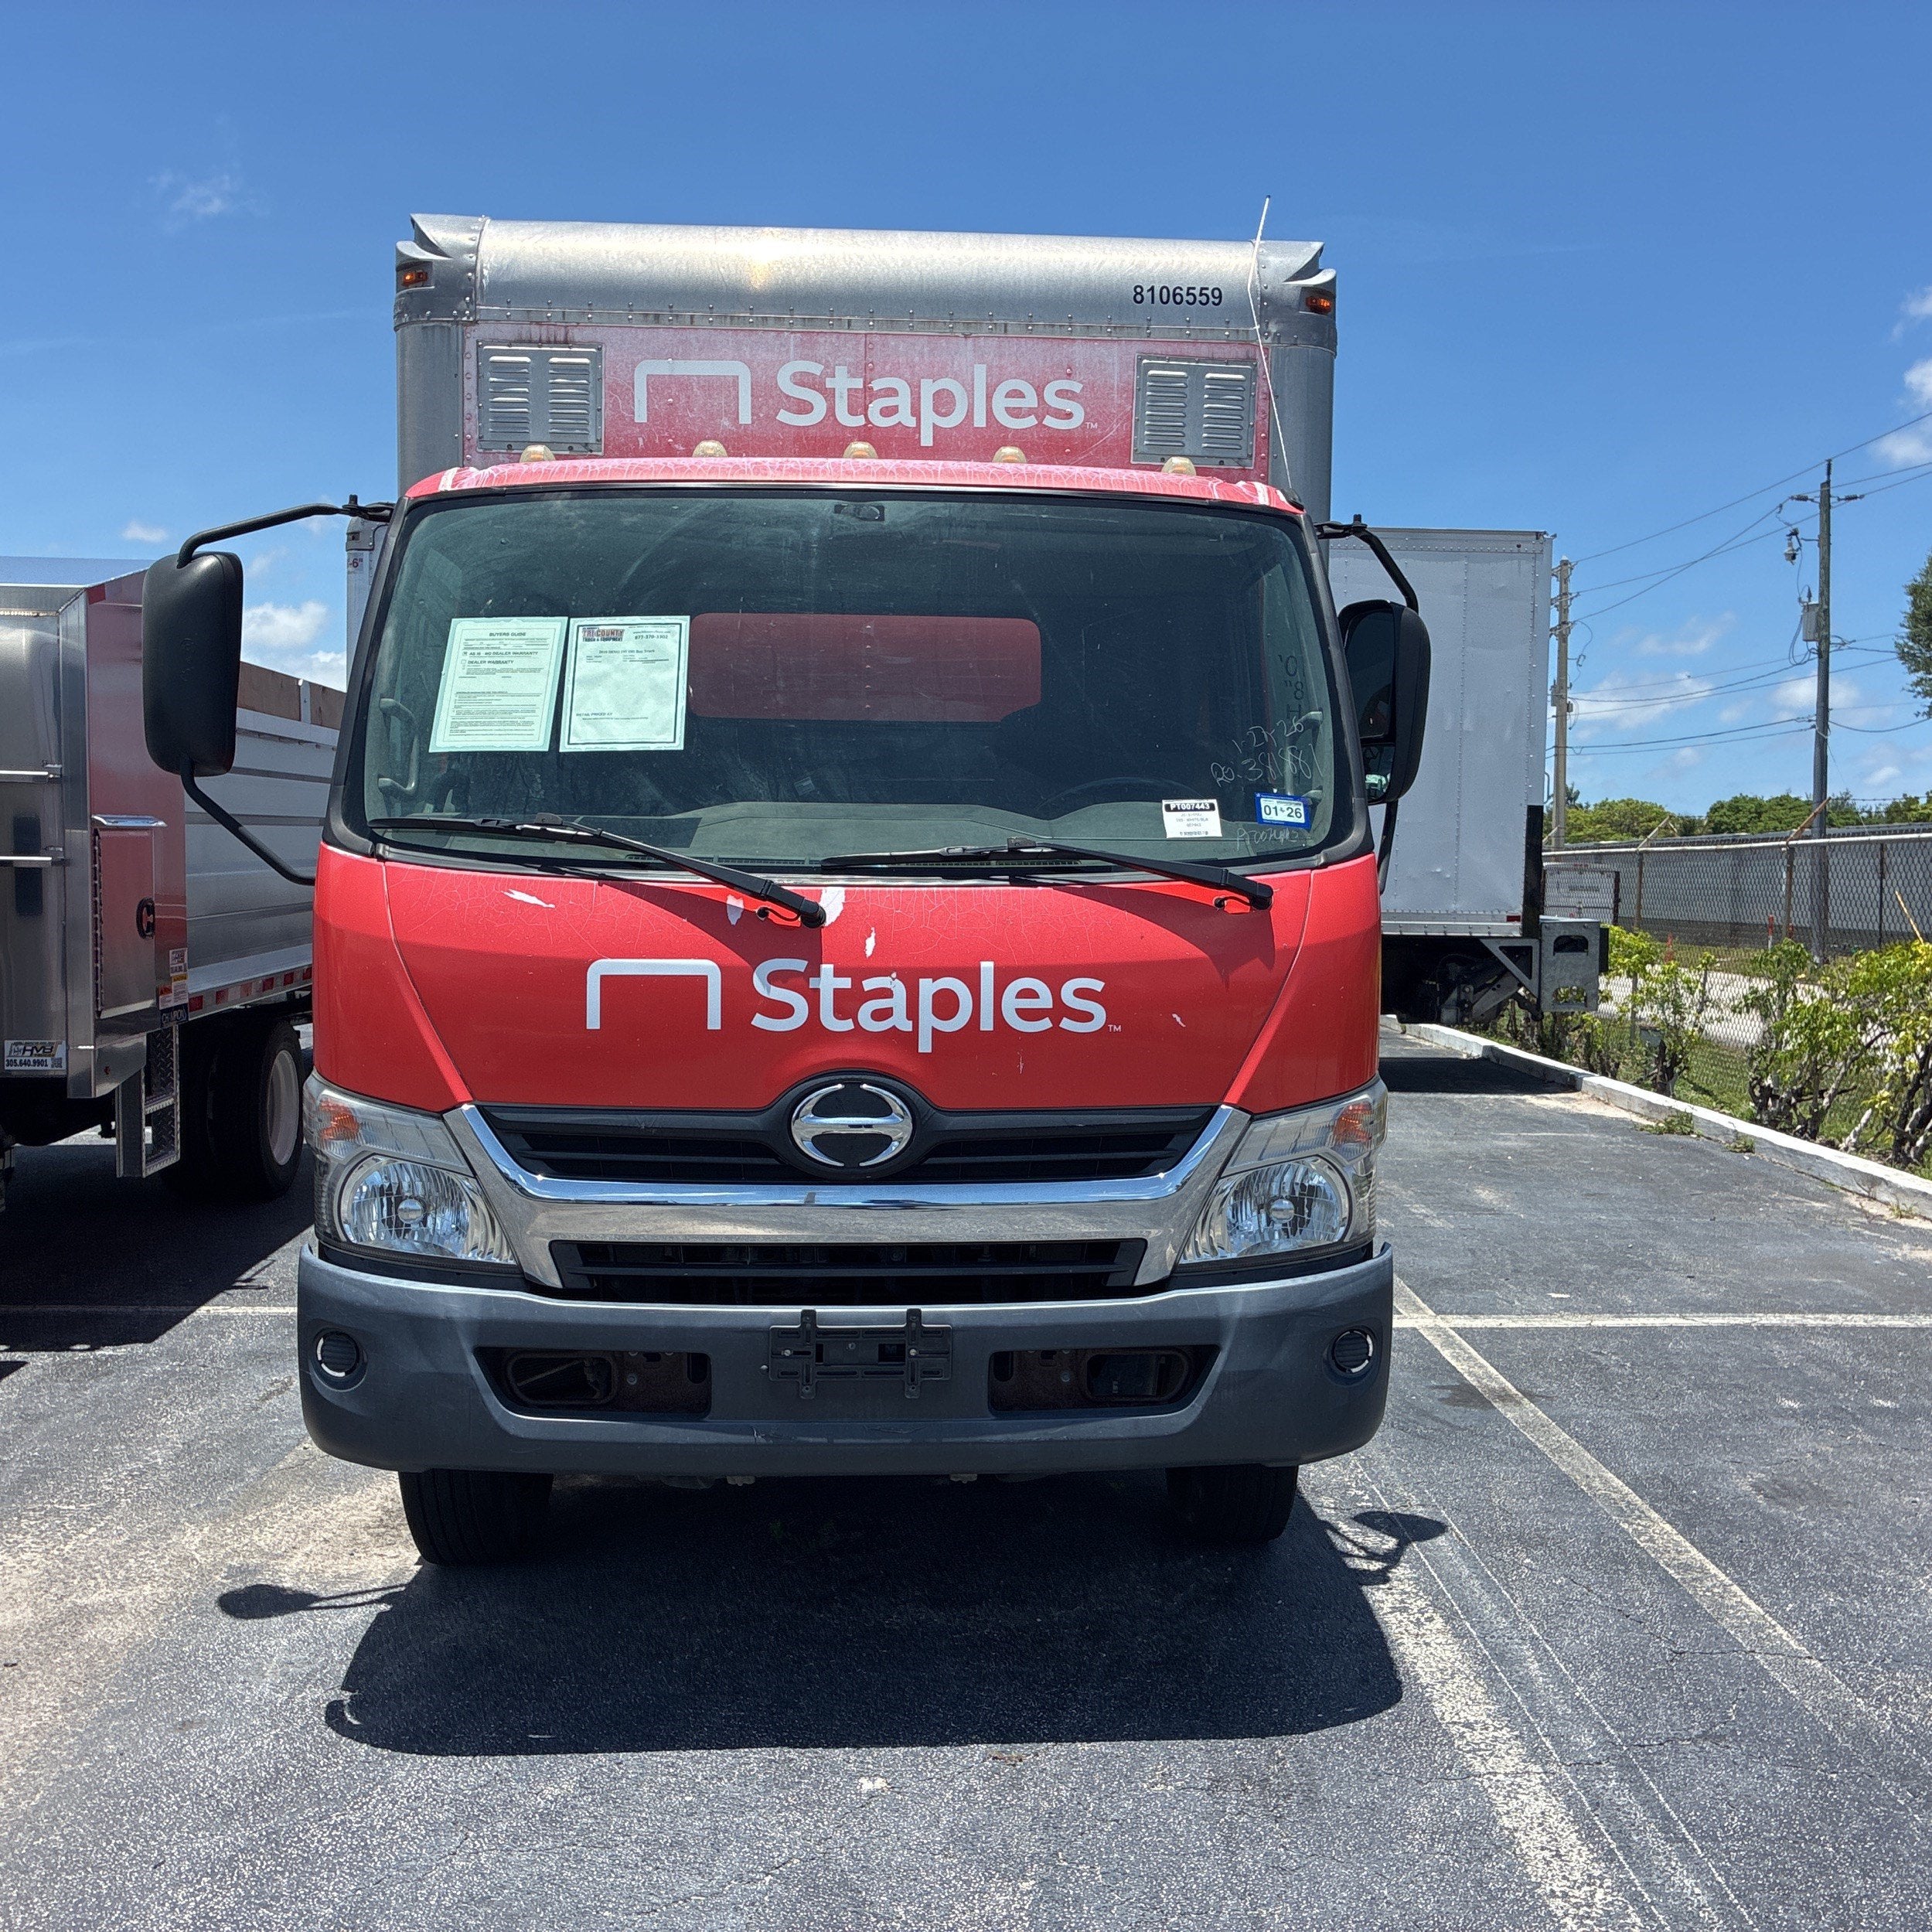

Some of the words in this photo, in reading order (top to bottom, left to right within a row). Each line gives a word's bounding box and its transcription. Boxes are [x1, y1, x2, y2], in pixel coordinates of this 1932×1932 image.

[1133, 285, 1222, 306] 8106559
[775, 360, 1085, 446] Staples
[596, 628, 625, 637] COUNTY
[1263, 804, 1279, 816] 01
[1286, 806, 1303, 819] 26
[751, 958, 1106, 1053] Staples
[5, 1058, 49, 1068] 305.640.9901
